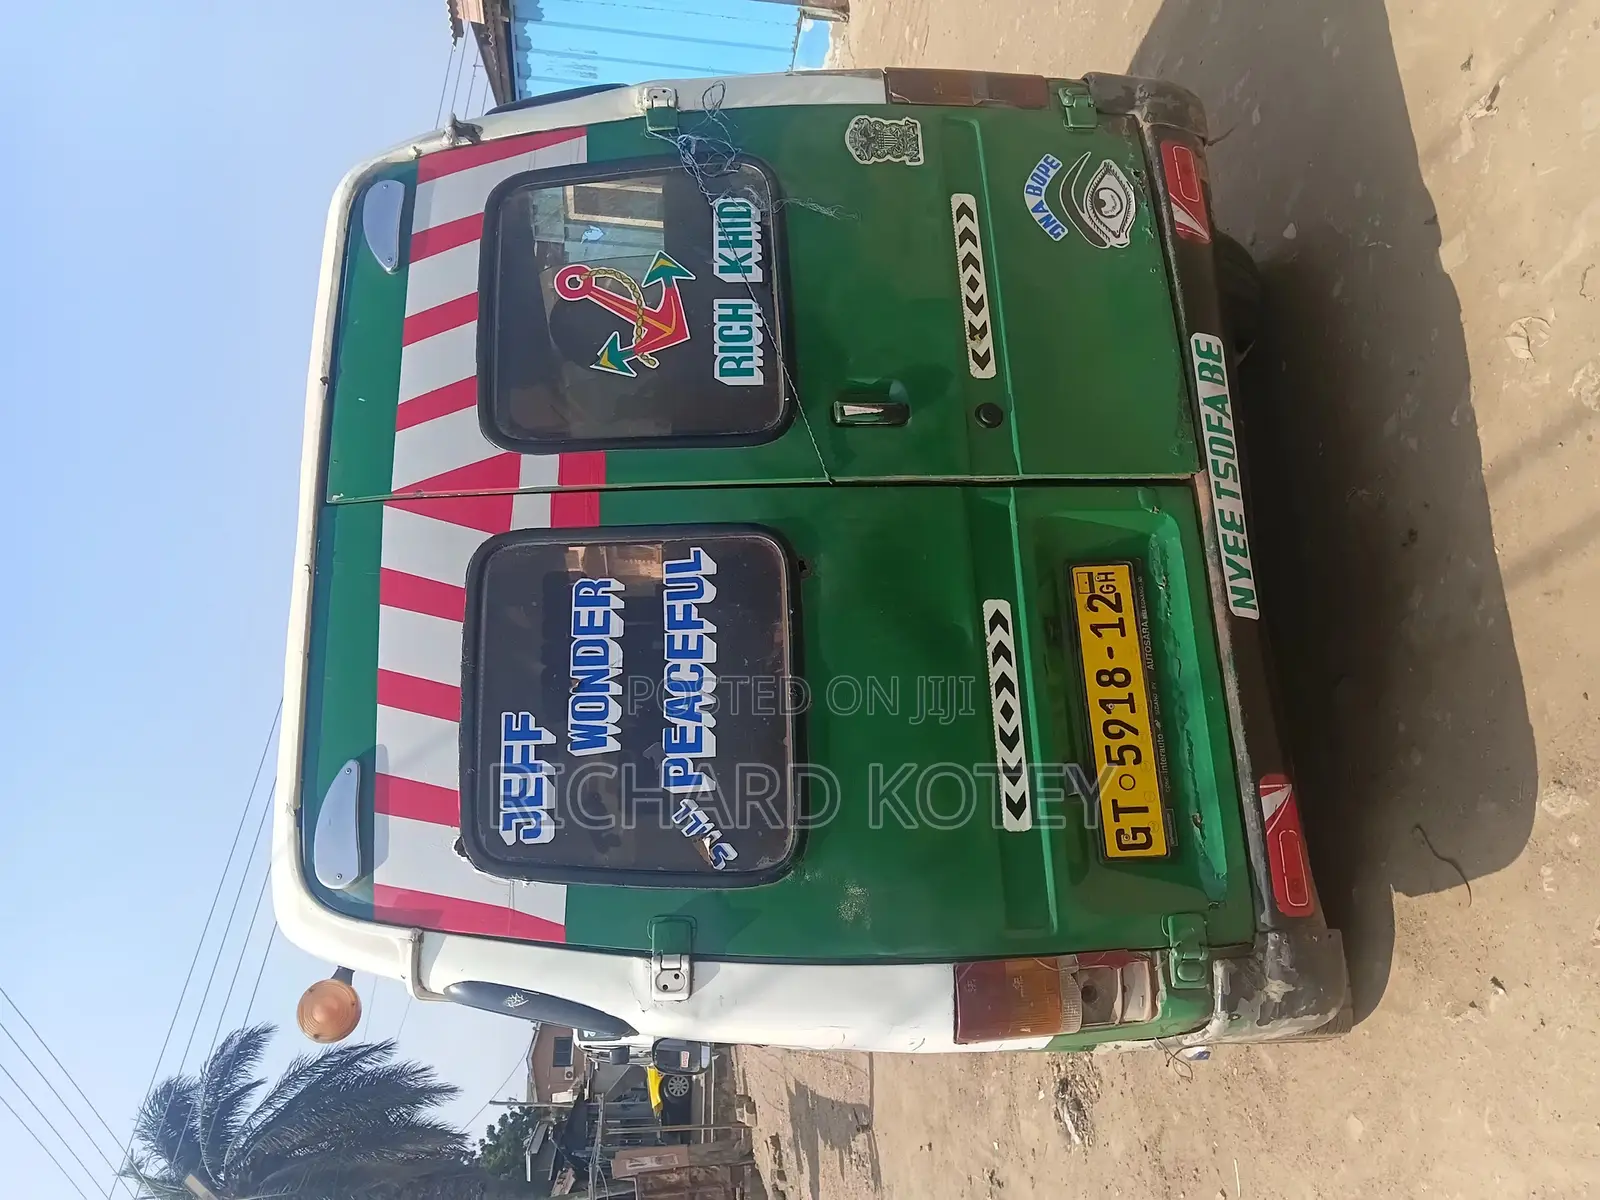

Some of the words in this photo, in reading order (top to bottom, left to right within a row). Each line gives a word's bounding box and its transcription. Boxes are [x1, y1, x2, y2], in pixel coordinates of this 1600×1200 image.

[713, 198, 762, 283] KHID
[713, 299, 763, 385] RICH
[1096, 571, 1117, 594] GH
[567, 578, 625, 756] WONDER
[662, 547, 717, 794] PEACEFUL
[1141, 620, 1155, 671] AUTOSARA
[499, 711, 556, 846] JEFF
[1155, 733, 1169, 774] interauto
[1111, 799, 1153, 851] GT
